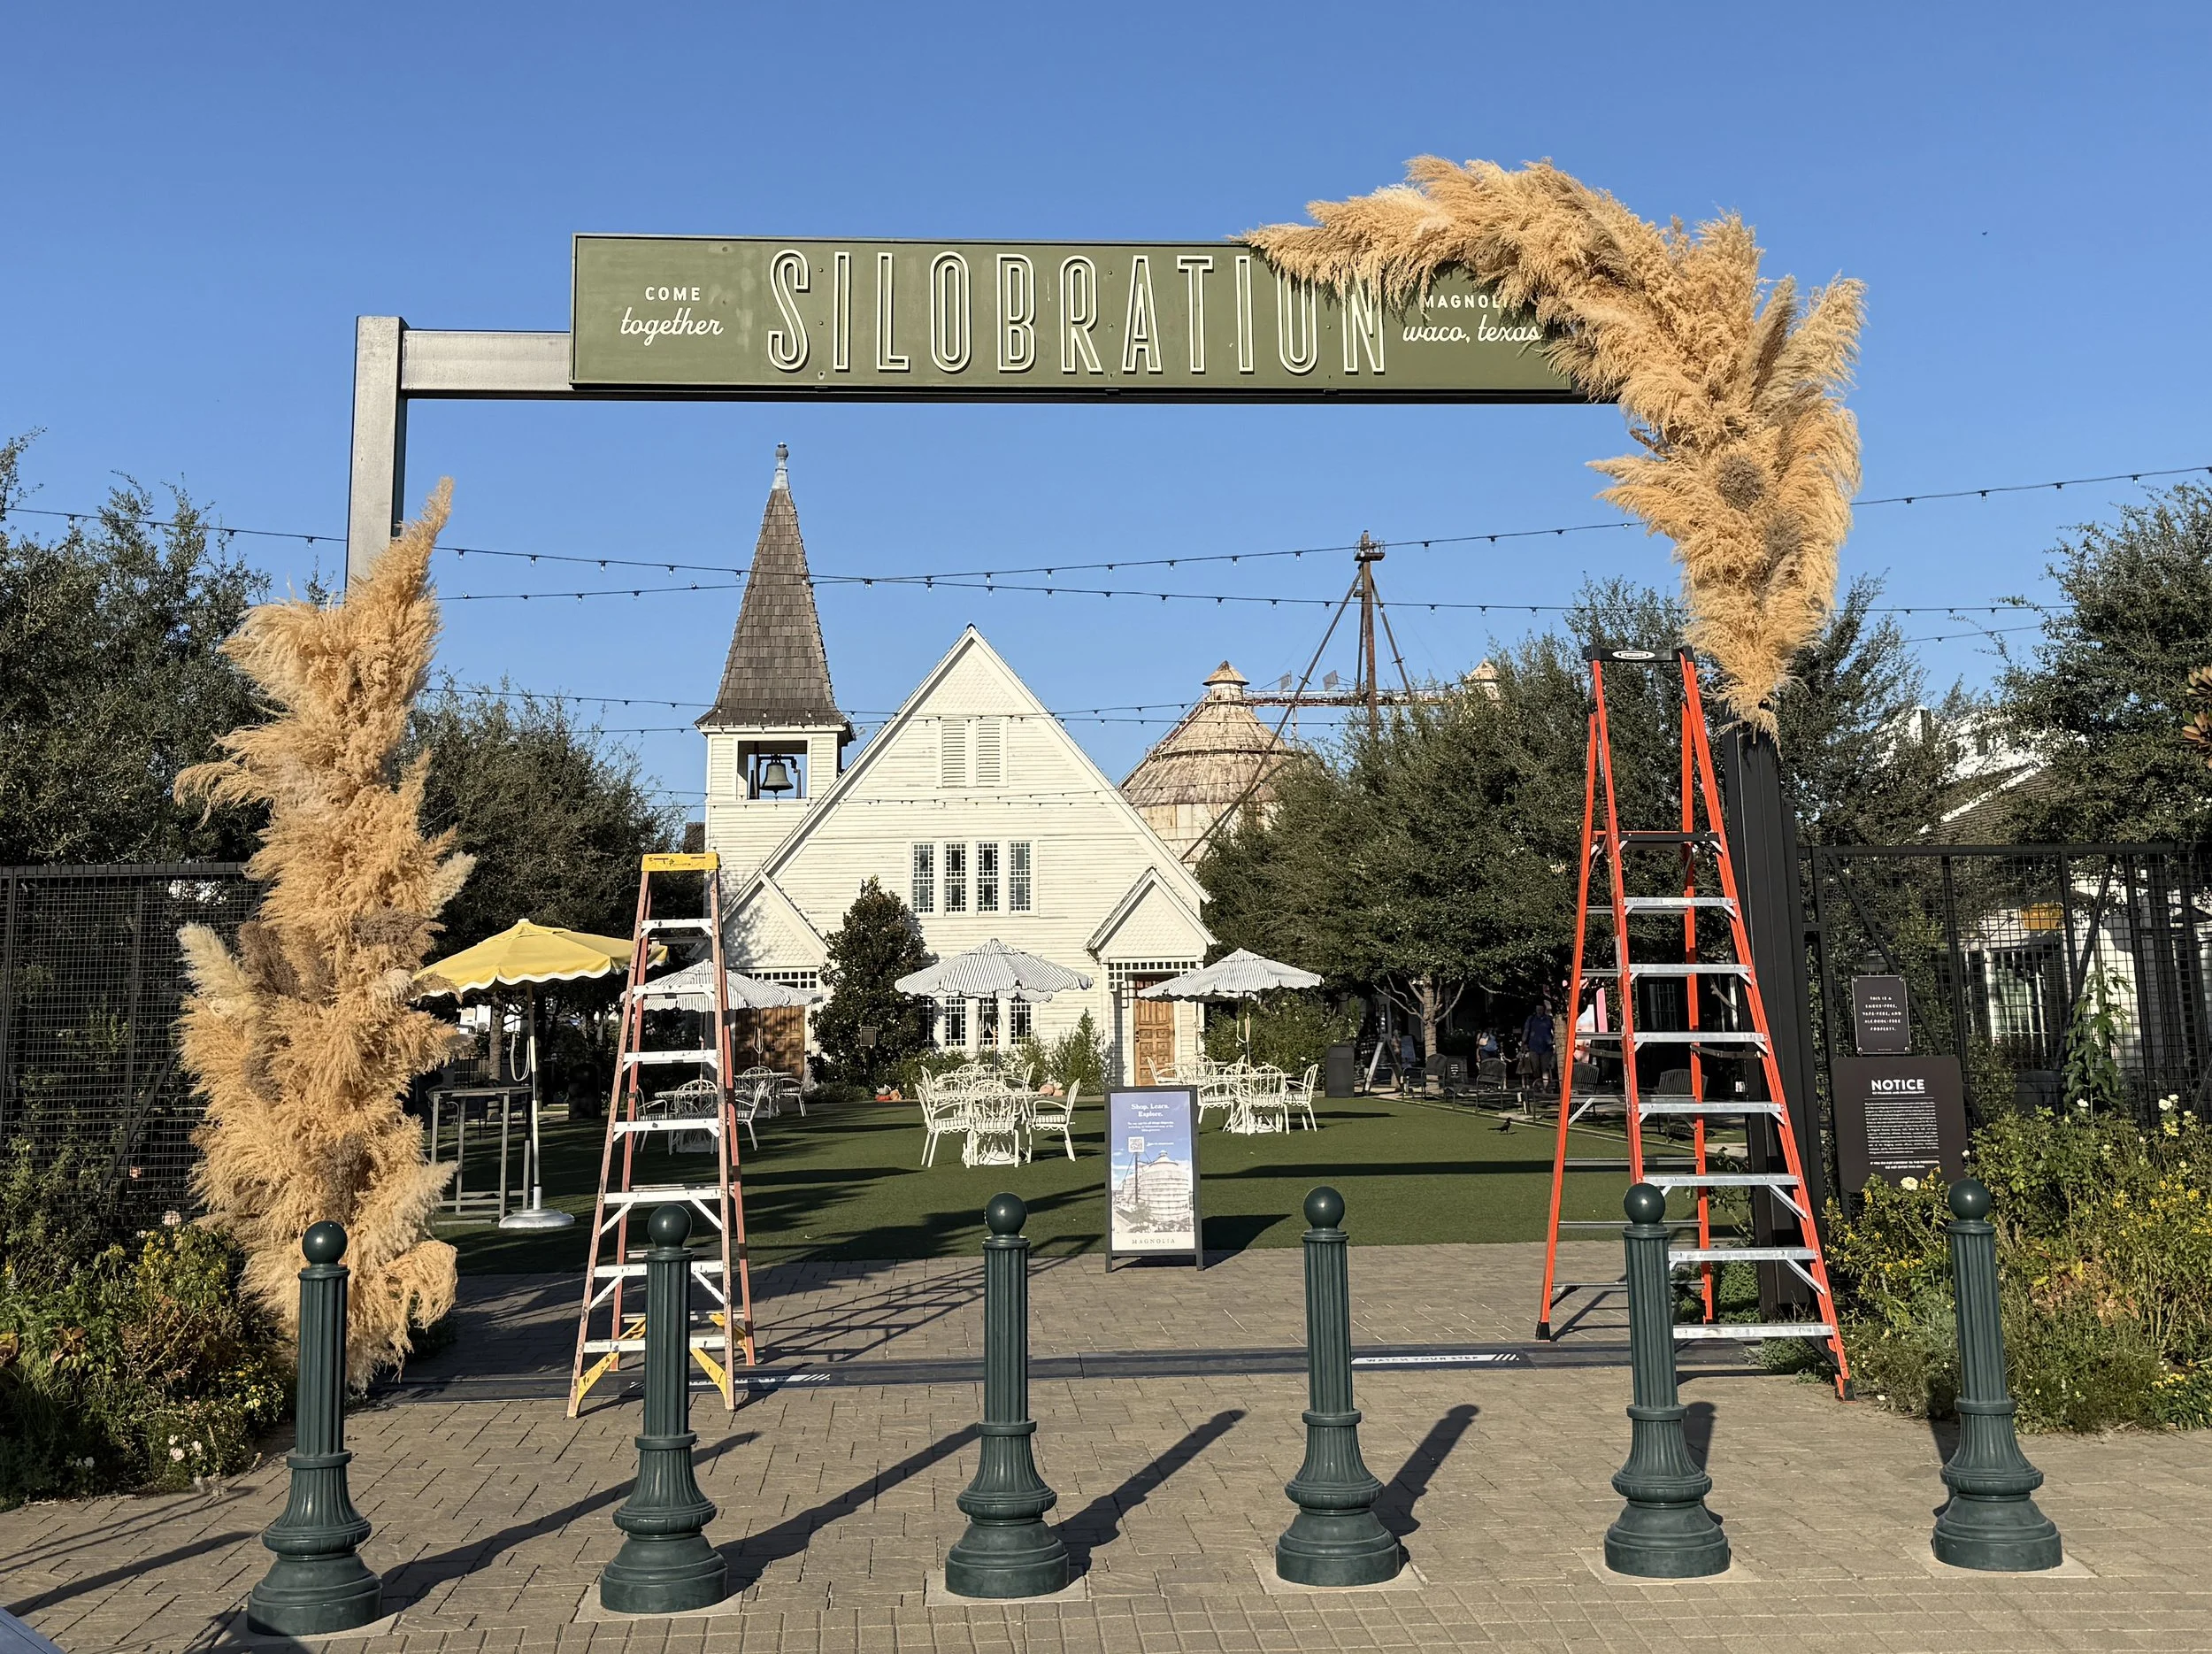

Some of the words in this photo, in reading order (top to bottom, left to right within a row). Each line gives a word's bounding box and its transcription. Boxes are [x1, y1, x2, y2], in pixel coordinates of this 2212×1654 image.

[645, 287, 701, 301] COME
[1424, 295, 1509, 309] MAGNOL
[767, 249, 1386, 374] SILOBRATION
[620, 306, 724, 347] together
[1402, 325, 1471, 343] waco,
[1477, 313, 1544, 342] texas
[1870, 1079, 1925, 1091] NOTICE
